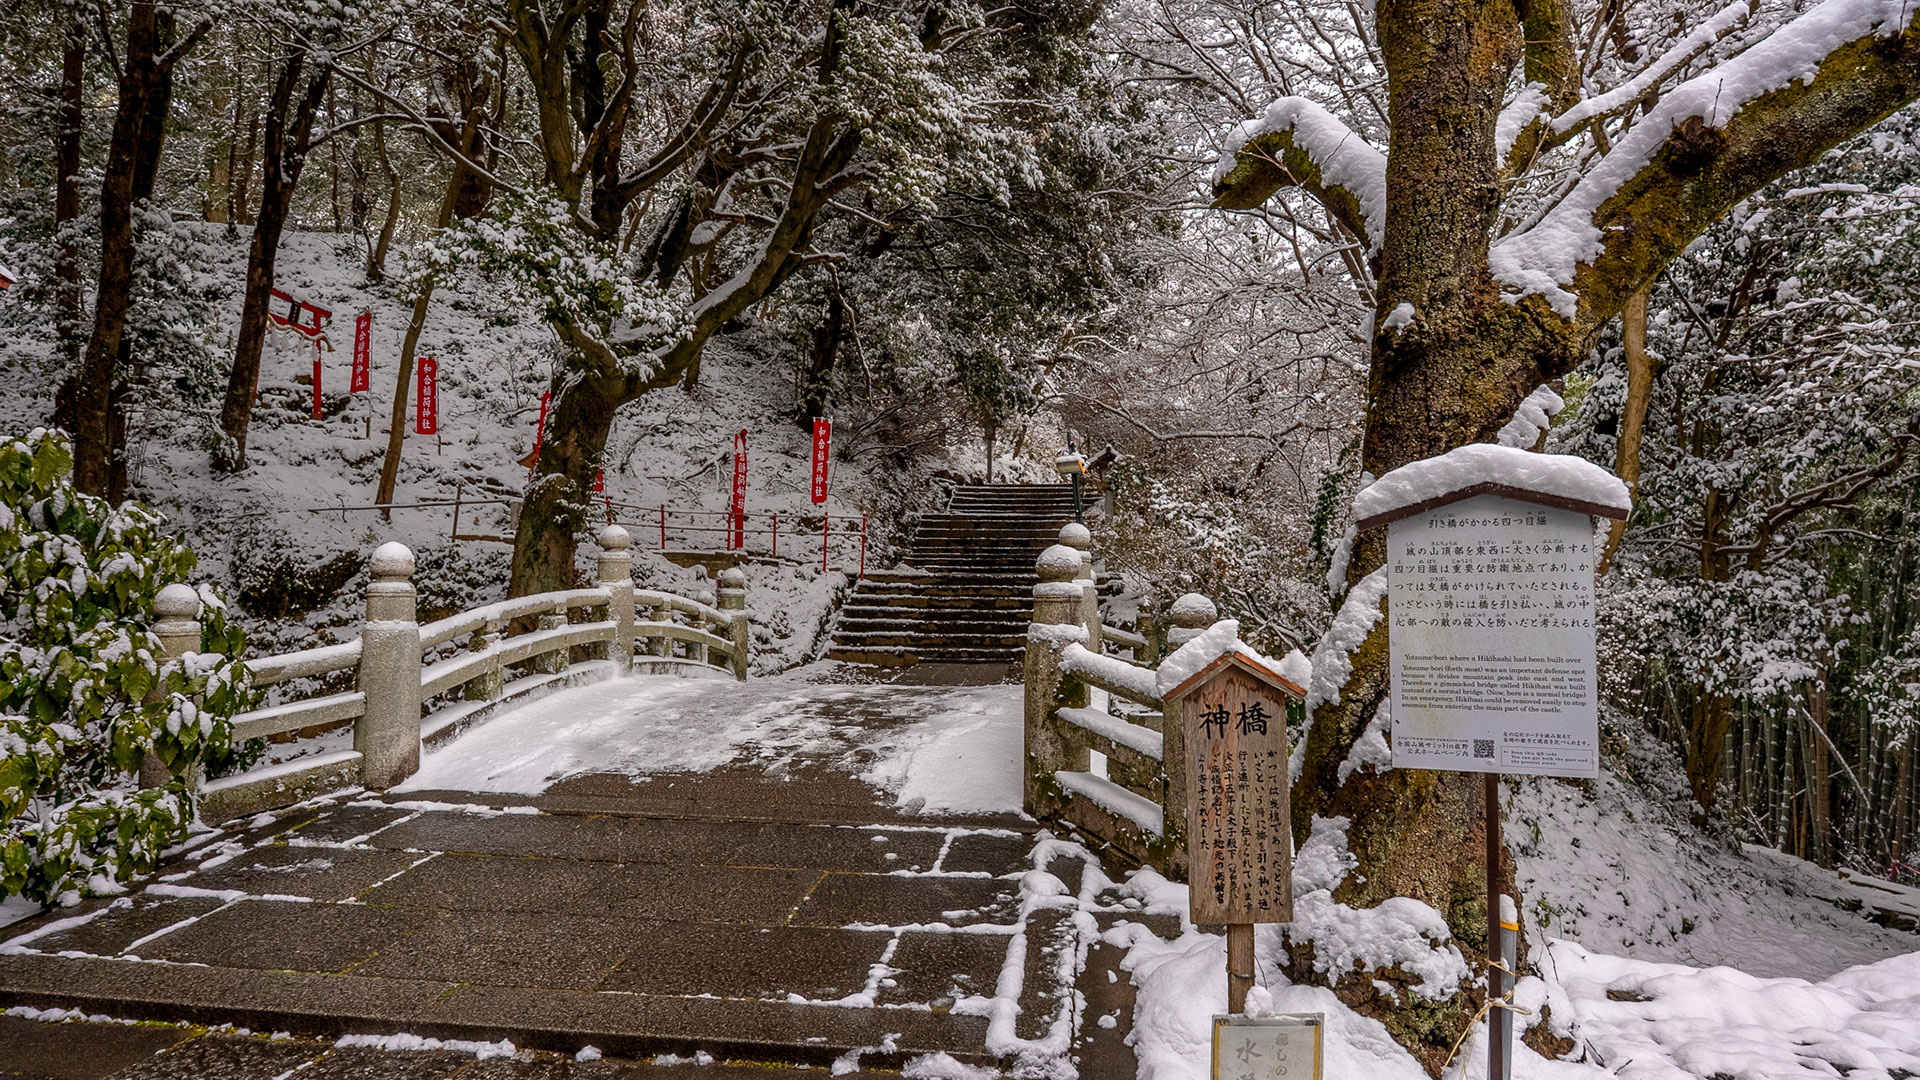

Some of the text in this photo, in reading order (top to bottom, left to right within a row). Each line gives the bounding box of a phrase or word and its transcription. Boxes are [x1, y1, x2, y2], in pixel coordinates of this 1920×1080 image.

[421, 363, 432, 430] 和合稲荷神社
[814, 426, 826, 497] 和合稲荷神社
[1428, 516, 1547, 528] 引き橋がかかる四つ目堀
[1406, 544, 1588, 556] 城の山頂部を東西に大きく分断する
[1394, 563, 1589, 574] 四ツ目堀は重要な防衛地点であり、か
[1394, 582, 1588, 592] つては曳橋がかけられていたとされる。
[1395, 599, 1590, 610] いざという時には橋を引き払い、城の中
[1396, 618, 1596, 628] 心部への敵の侵入を防いだと考えられる。
[1198, 702, 1272, 740] 神橋
